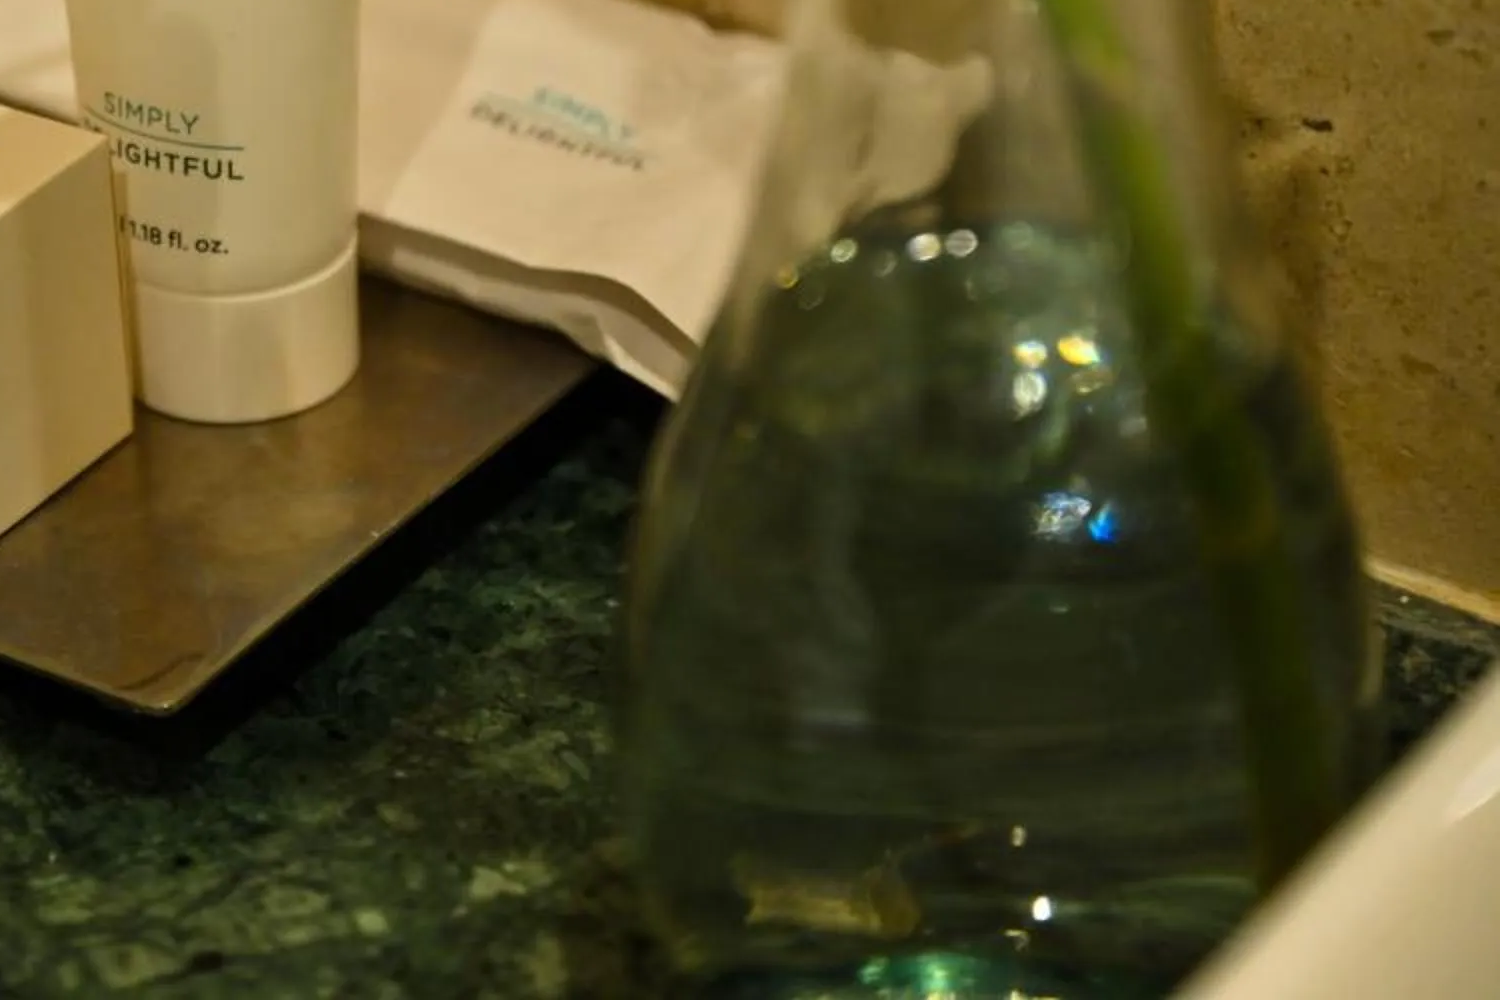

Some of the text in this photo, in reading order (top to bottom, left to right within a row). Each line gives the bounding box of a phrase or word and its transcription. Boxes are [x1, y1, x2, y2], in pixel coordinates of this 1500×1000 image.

[104, 91, 199, 135] SIMPLY
[84, 117, 245, 180] IGHTFUL
[168, 231, 189, 252] fl.
[195, 238, 230, 254] oz.
